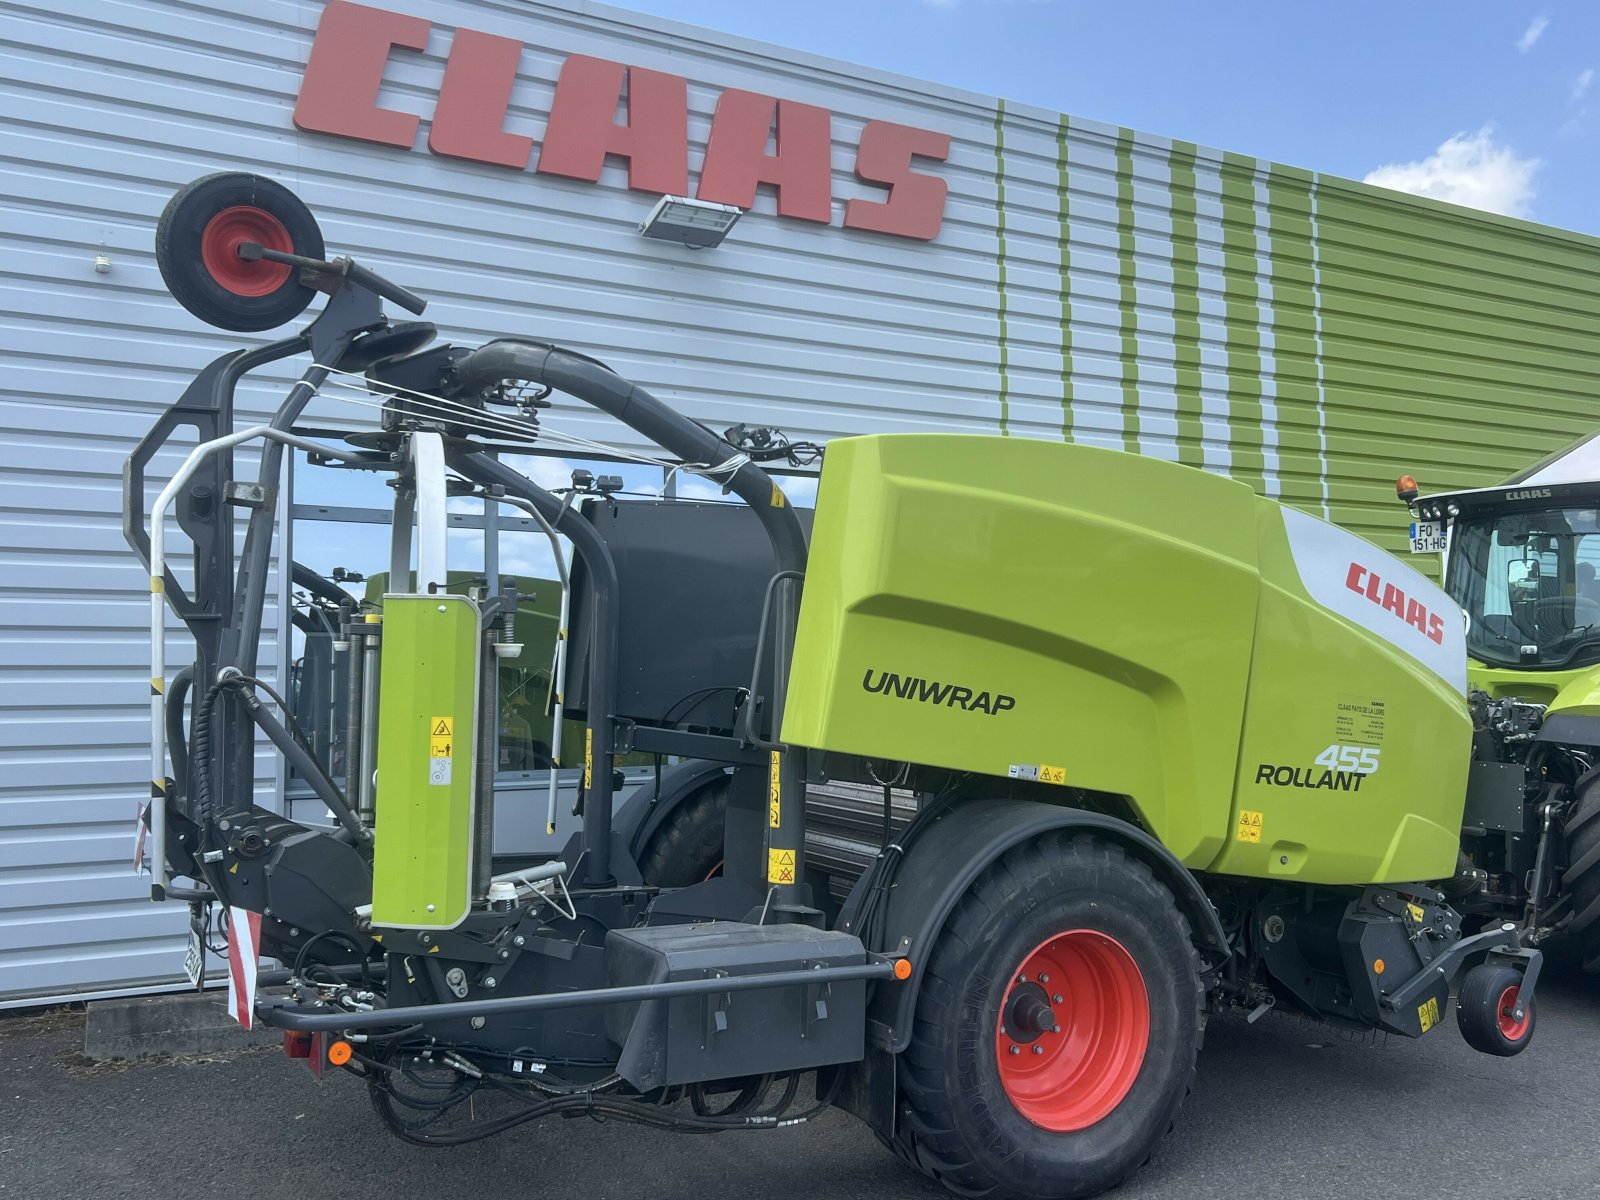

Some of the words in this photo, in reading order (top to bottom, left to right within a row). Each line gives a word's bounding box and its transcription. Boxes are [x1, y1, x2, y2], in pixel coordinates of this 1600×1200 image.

[293, 0, 950, 241] CLAAS
[1505, 488, 1552, 501] CLAAS
[1412, 537, 1446, 551] 151-HG
[1345, 562, 1444, 646] CLAAS
[862, 669, 1016, 716] UNIWRAP
[1314, 744, 1381, 774] 455
[1255, 763, 1367, 792] ROLLANT
